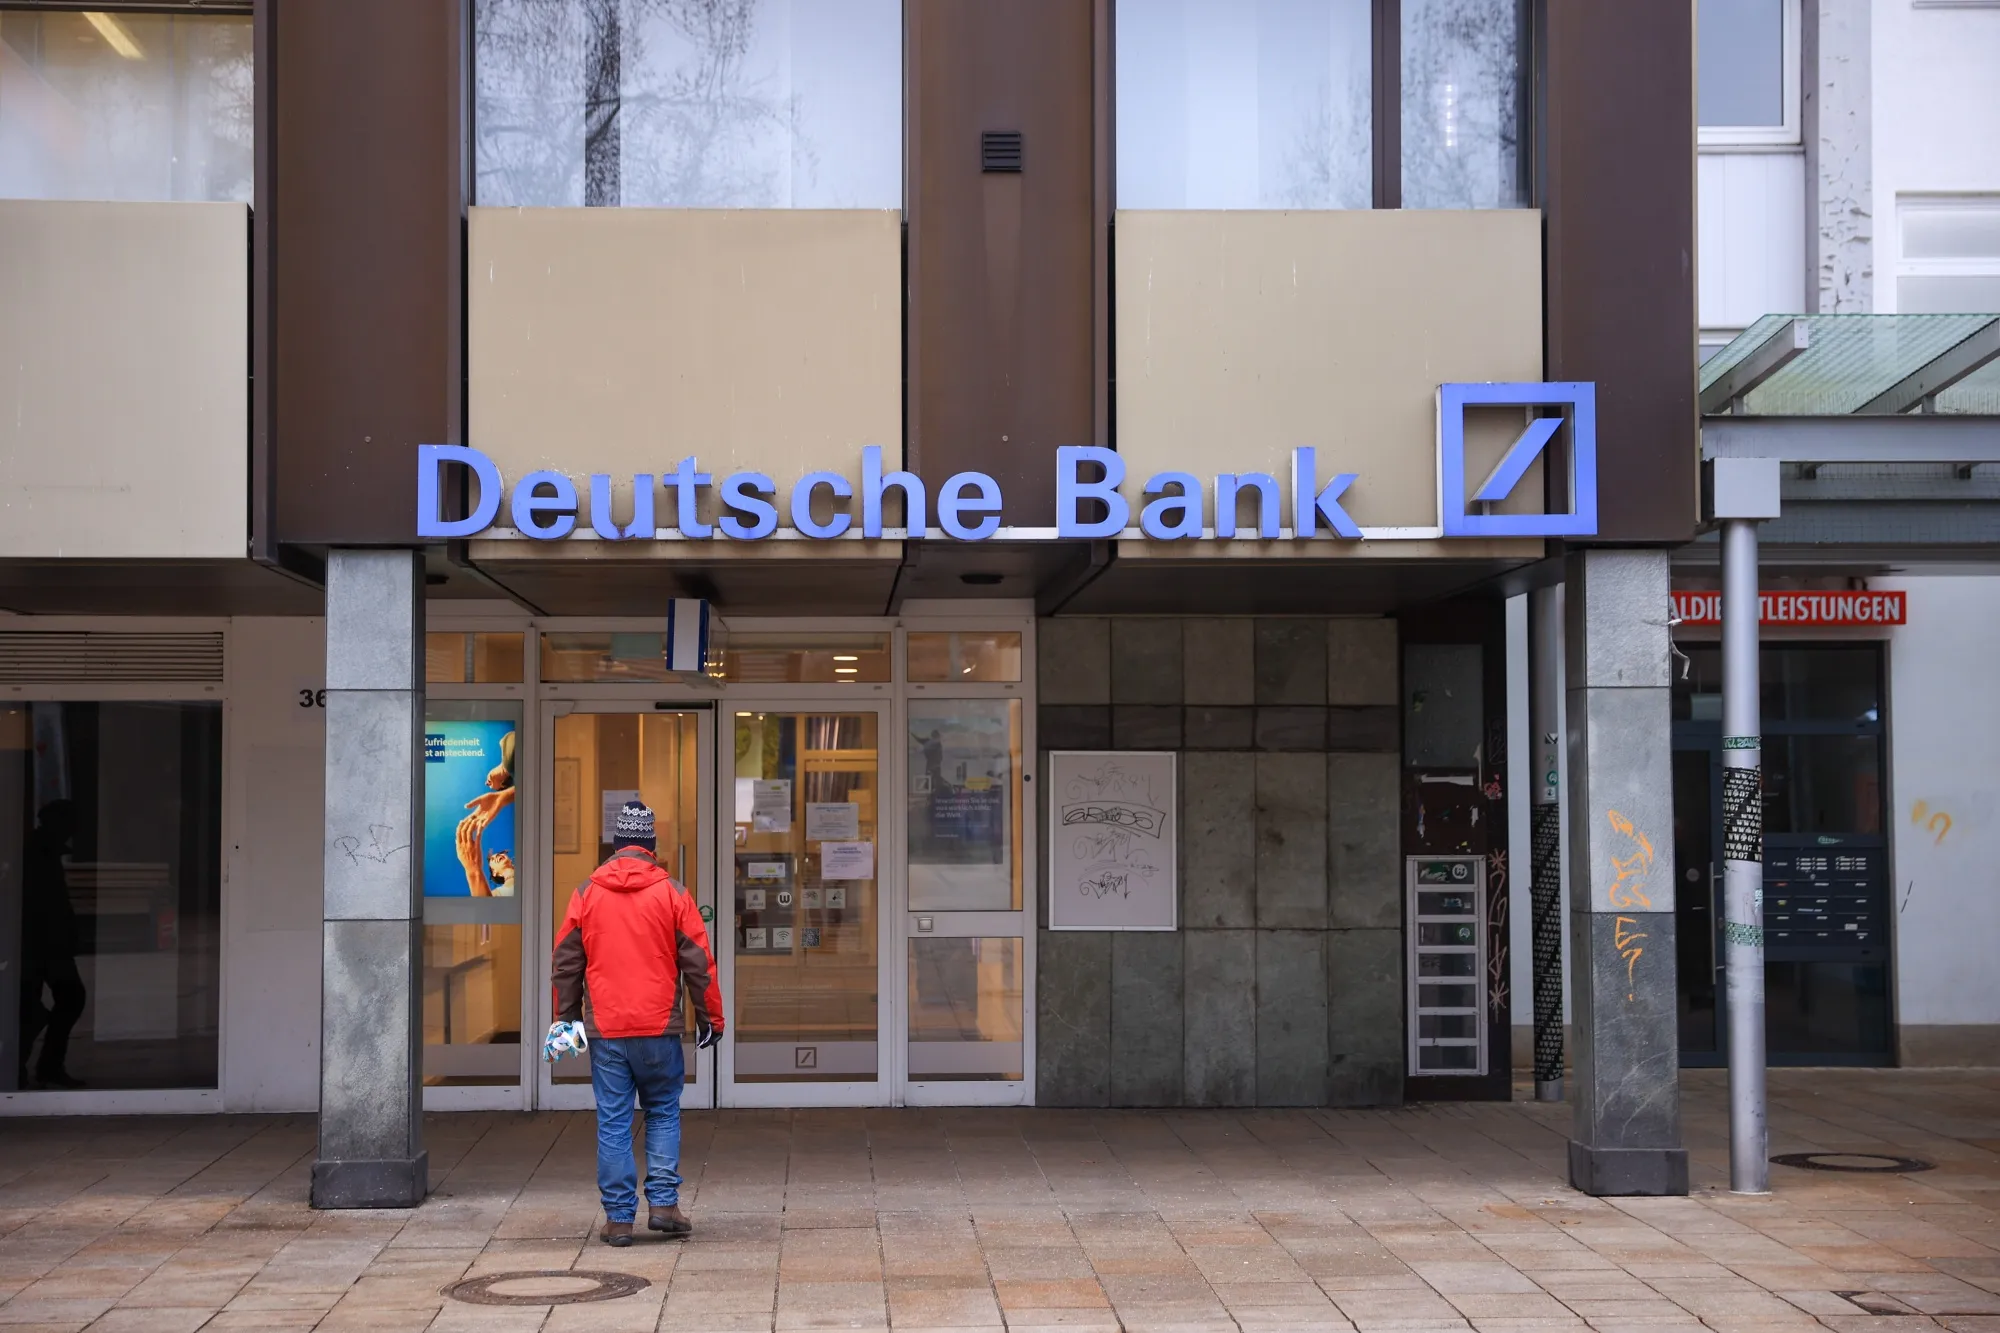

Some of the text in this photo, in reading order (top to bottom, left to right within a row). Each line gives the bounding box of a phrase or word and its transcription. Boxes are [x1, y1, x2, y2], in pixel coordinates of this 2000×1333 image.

[417, 444, 1364, 541] Deutsche Bank
[1671, 596, 1900, 621] ALDIETLEISTUNGEN
[424, 738, 480, 747] Zufriedenheit
[434, 748, 486, 757] ansteckend.
